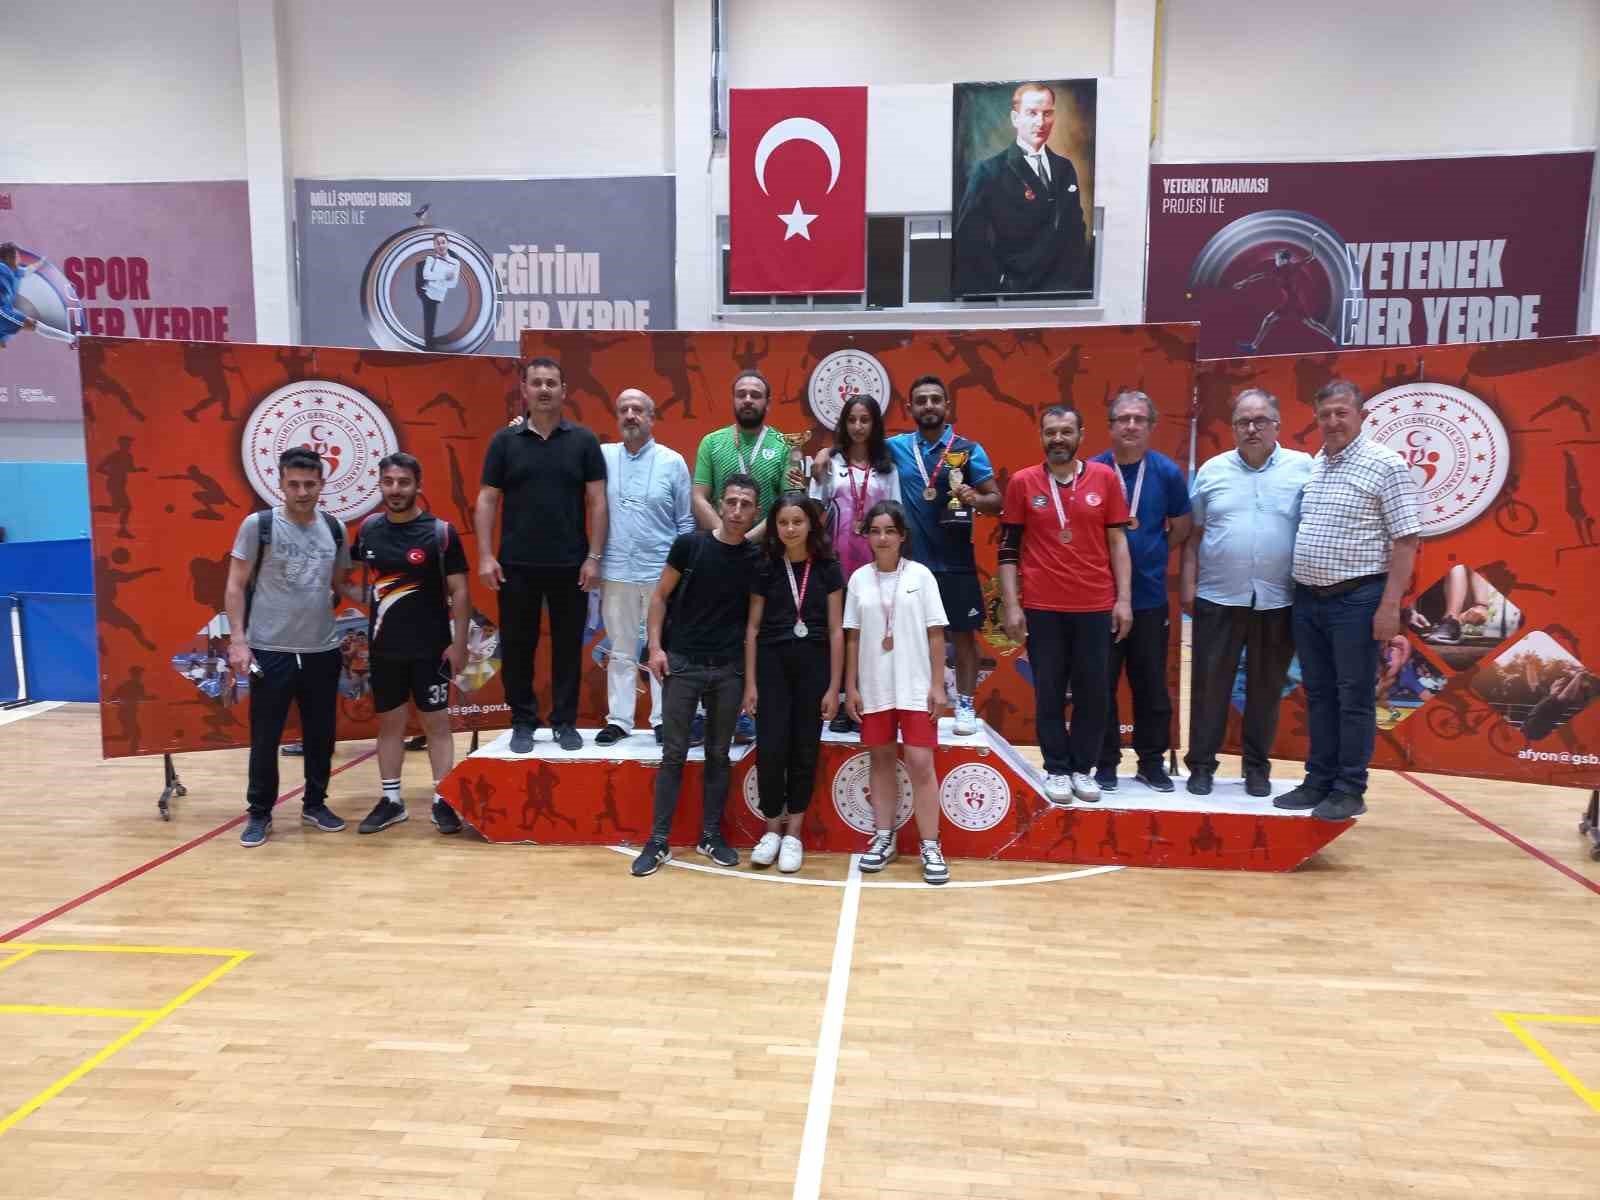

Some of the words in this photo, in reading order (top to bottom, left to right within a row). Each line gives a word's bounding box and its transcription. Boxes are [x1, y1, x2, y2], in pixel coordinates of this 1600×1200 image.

[337, 191, 377, 206] SPORCU
[378, 191, 412, 206] BURSU
[1162, 178, 1209, 194] YETENEK
[1211, 177, 1269, 193] TARAMASI
[1162, 197, 1207, 214] PROJESİ
[1209, 197, 1225, 214] İLE
[63, 256, 150, 301] SPOR
[493, 244, 601, 295] EĞİTİM
[1345, 239, 1507, 291] YETENEK
[67, 306, 126, 338] HER
[494, 299, 550, 341] HER
[1342, 296, 1413, 346] HER
[1422, 294, 1542, 344] YERDE
[429, 683, 449, 704] 35
